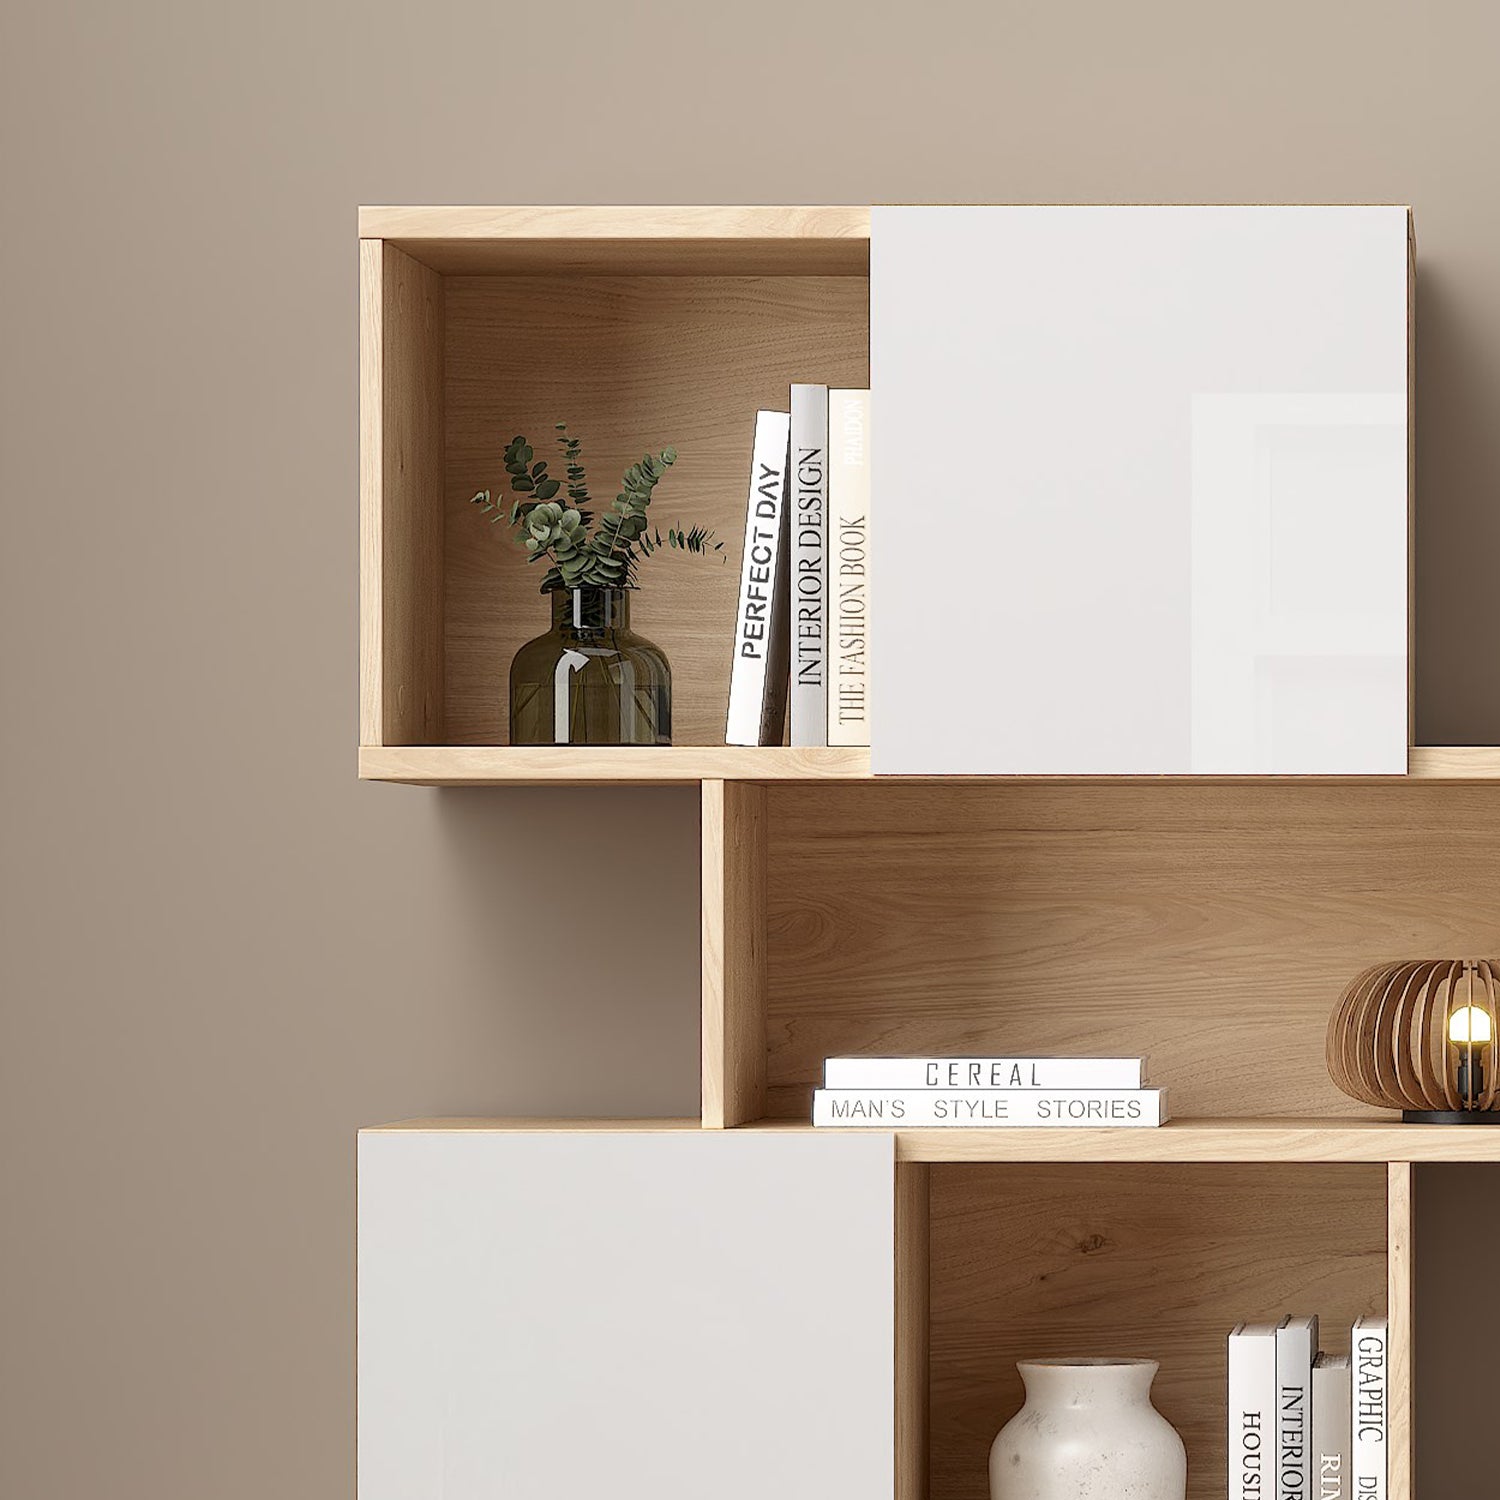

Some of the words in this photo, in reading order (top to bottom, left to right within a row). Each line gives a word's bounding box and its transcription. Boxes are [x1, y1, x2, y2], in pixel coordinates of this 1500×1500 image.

[756, 462, 781, 519] DAY
[798, 448, 822, 550] DESIGN
[839, 515, 865, 577] BOOK
[741, 527, 774, 659] PERFECT
[798, 556, 822, 687] INTERIOR
[839, 583, 865, 677] FASHION
[839, 685, 865, 725] THE
[831, 1099, 906, 1119] MAN'S
[933, 1099, 1009, 1119] STYLE
[1036, 1099, 1142, 1119] STORIES
[926, 1063, 1041, 1086] CEREAL
[1358, 1336, 1384, 1443] GRAPHIC
